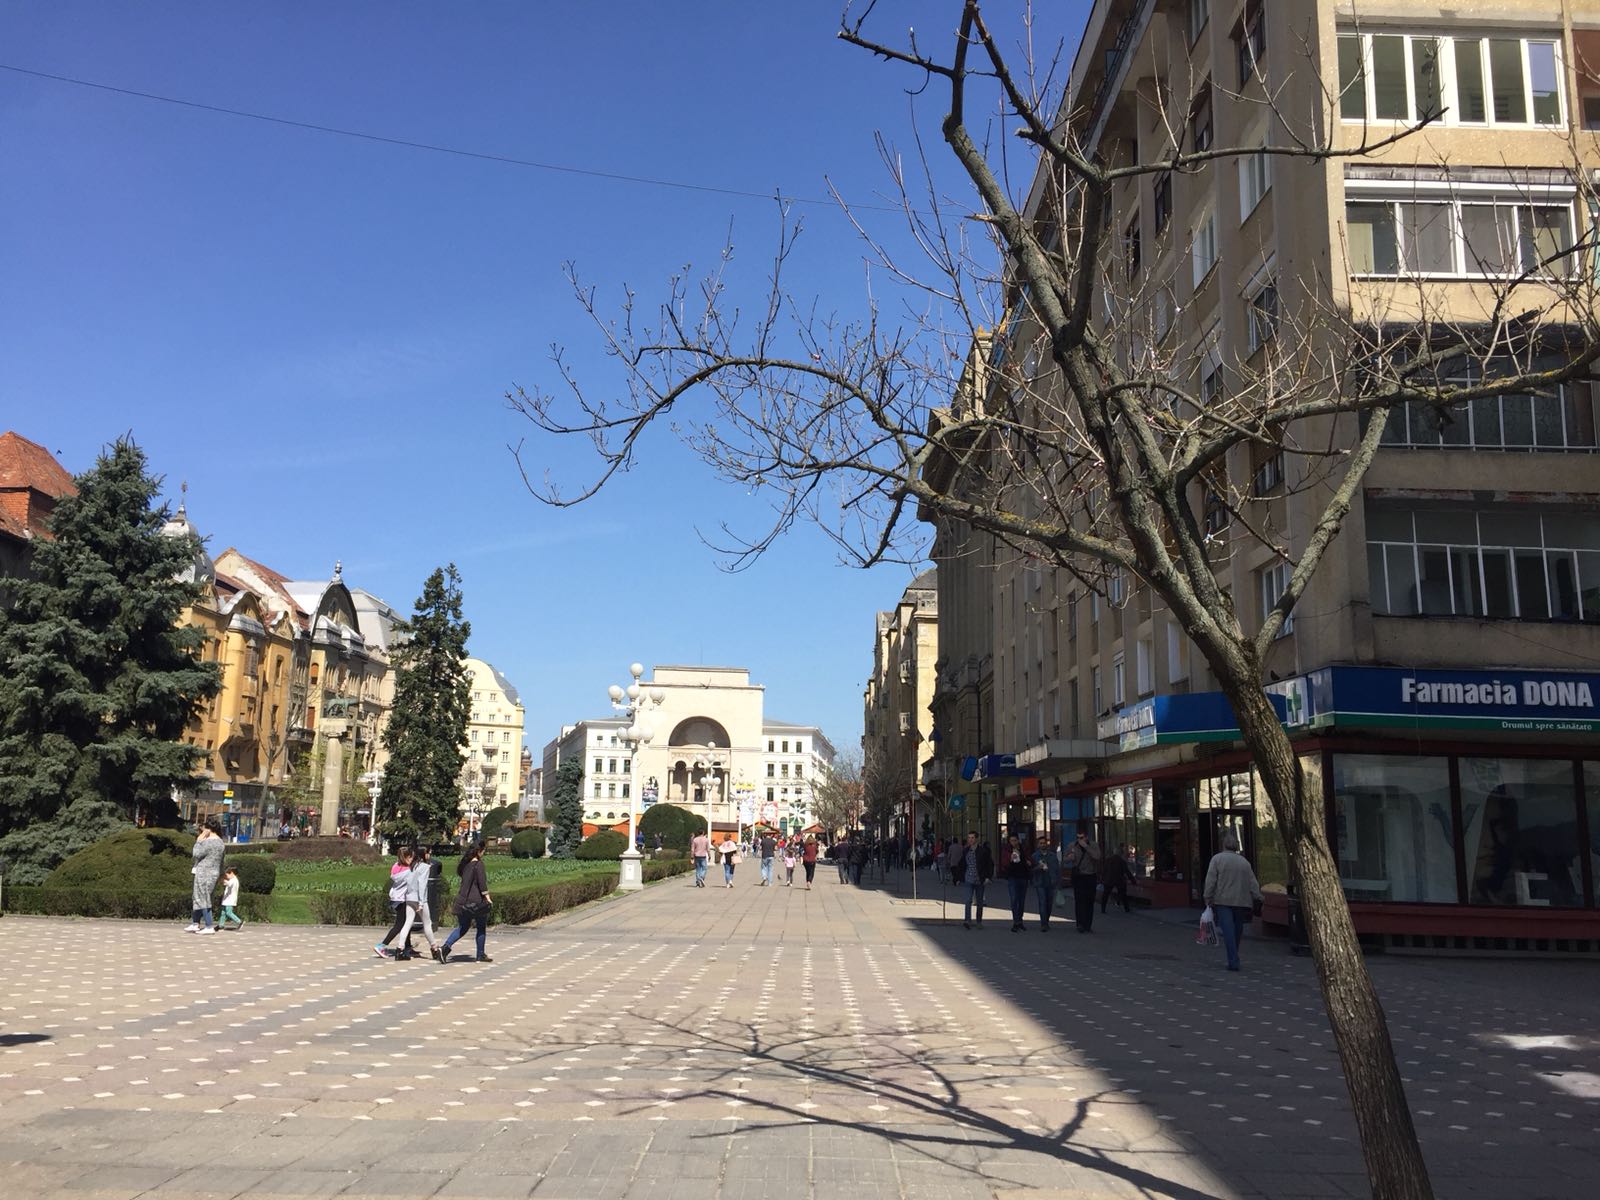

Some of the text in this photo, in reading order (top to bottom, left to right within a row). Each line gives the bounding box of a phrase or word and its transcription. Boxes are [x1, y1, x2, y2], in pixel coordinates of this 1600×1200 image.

[1401, 677, 1595, 708] Farmacia DONA
[1502, 721, 1533, 729] Drumul
[1535, 723, 1554, 731] spre
